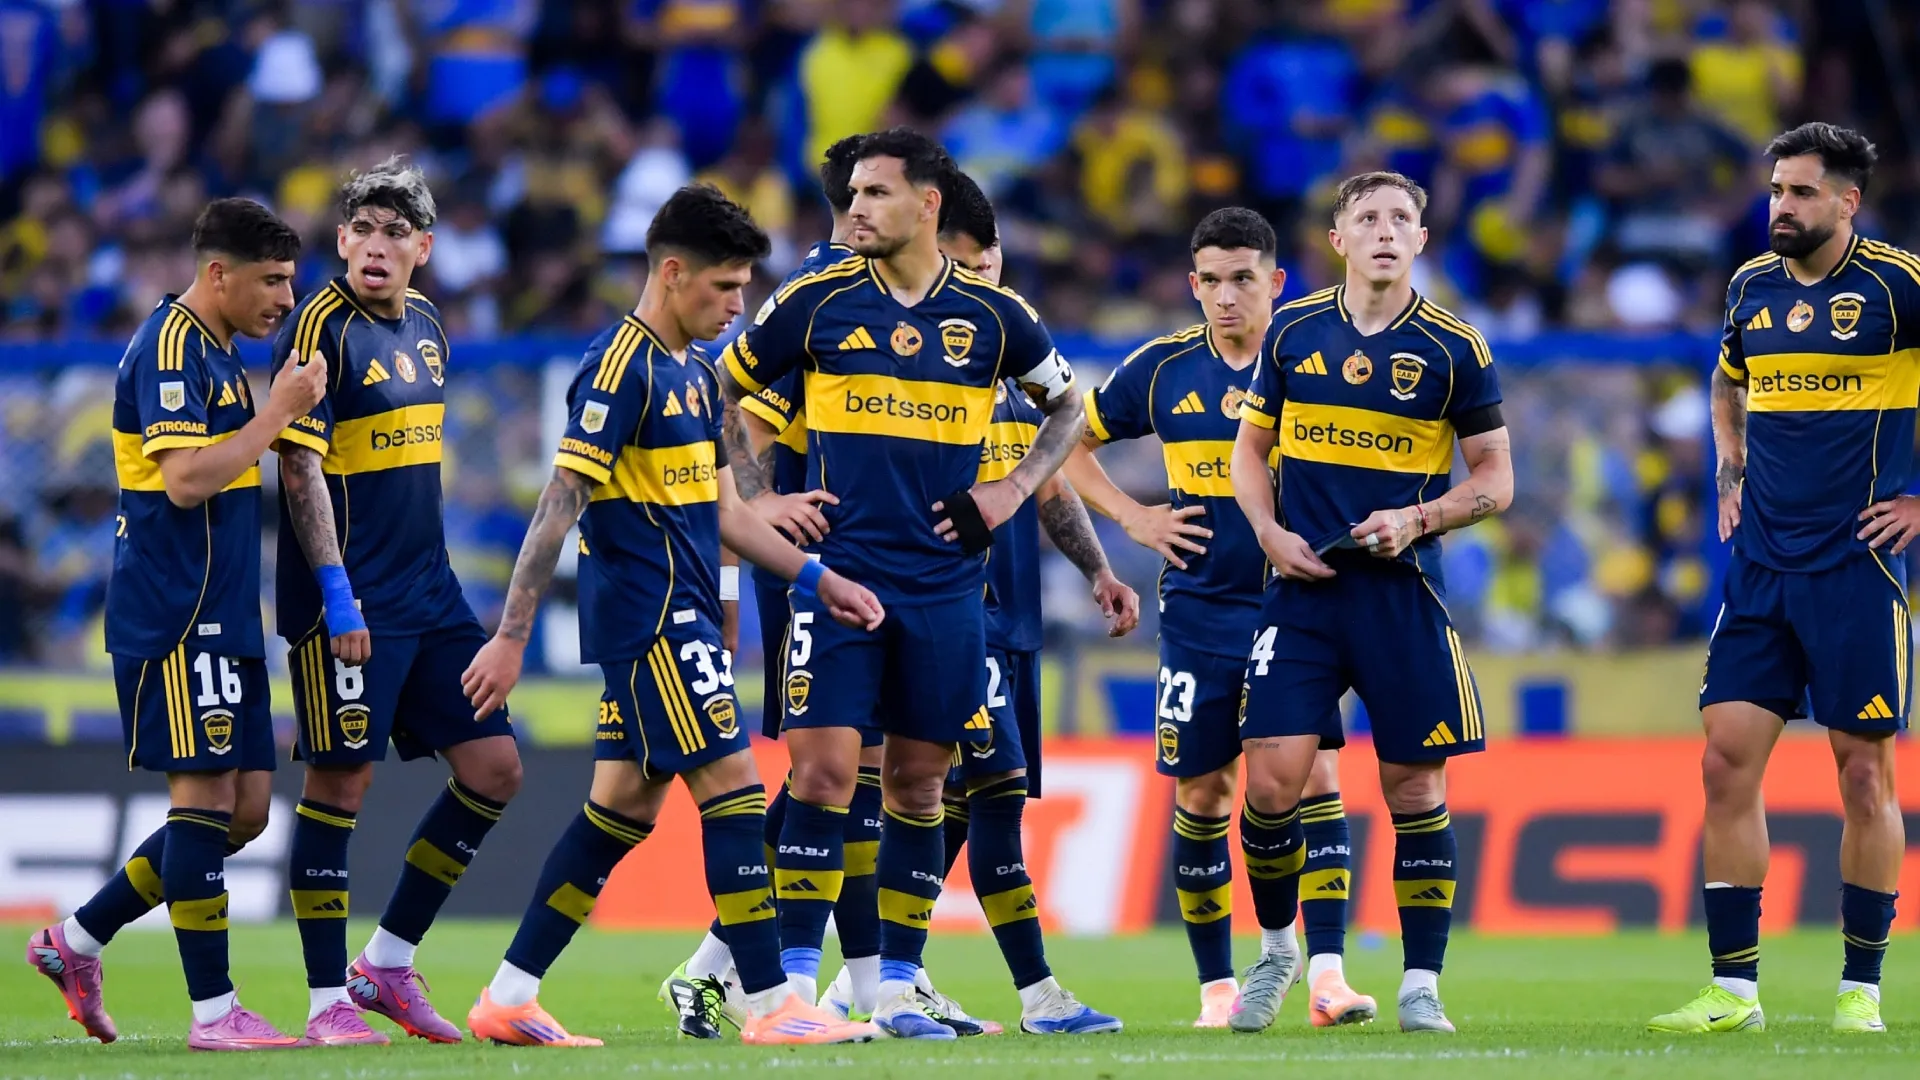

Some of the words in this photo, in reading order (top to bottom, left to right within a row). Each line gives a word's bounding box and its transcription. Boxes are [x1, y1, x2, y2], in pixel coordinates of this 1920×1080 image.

[845, 389, 967, 424] betsson
[145, 420, 207, 438] CETROGAR
[371, 423, 443, 451] betsso
[1294, 417, 1413, 454] betsson
[791, 611, 814, 667] 5
[1245, 626, 1278, 676] 4
[193, 651, 242, 707] 16
[334, 657, 364, 701] 8
[680, 639, 735, 696] 33
[985, 656, 1006, 709] 2
[599, 700, 624, 725] ax
[1159, 666, 1196, 723] 23
[779, 844, 830, 857] CABJ
[1179, 861, 1226, 877] CABJ
[1402, 859, 1453, 869] CABJ
